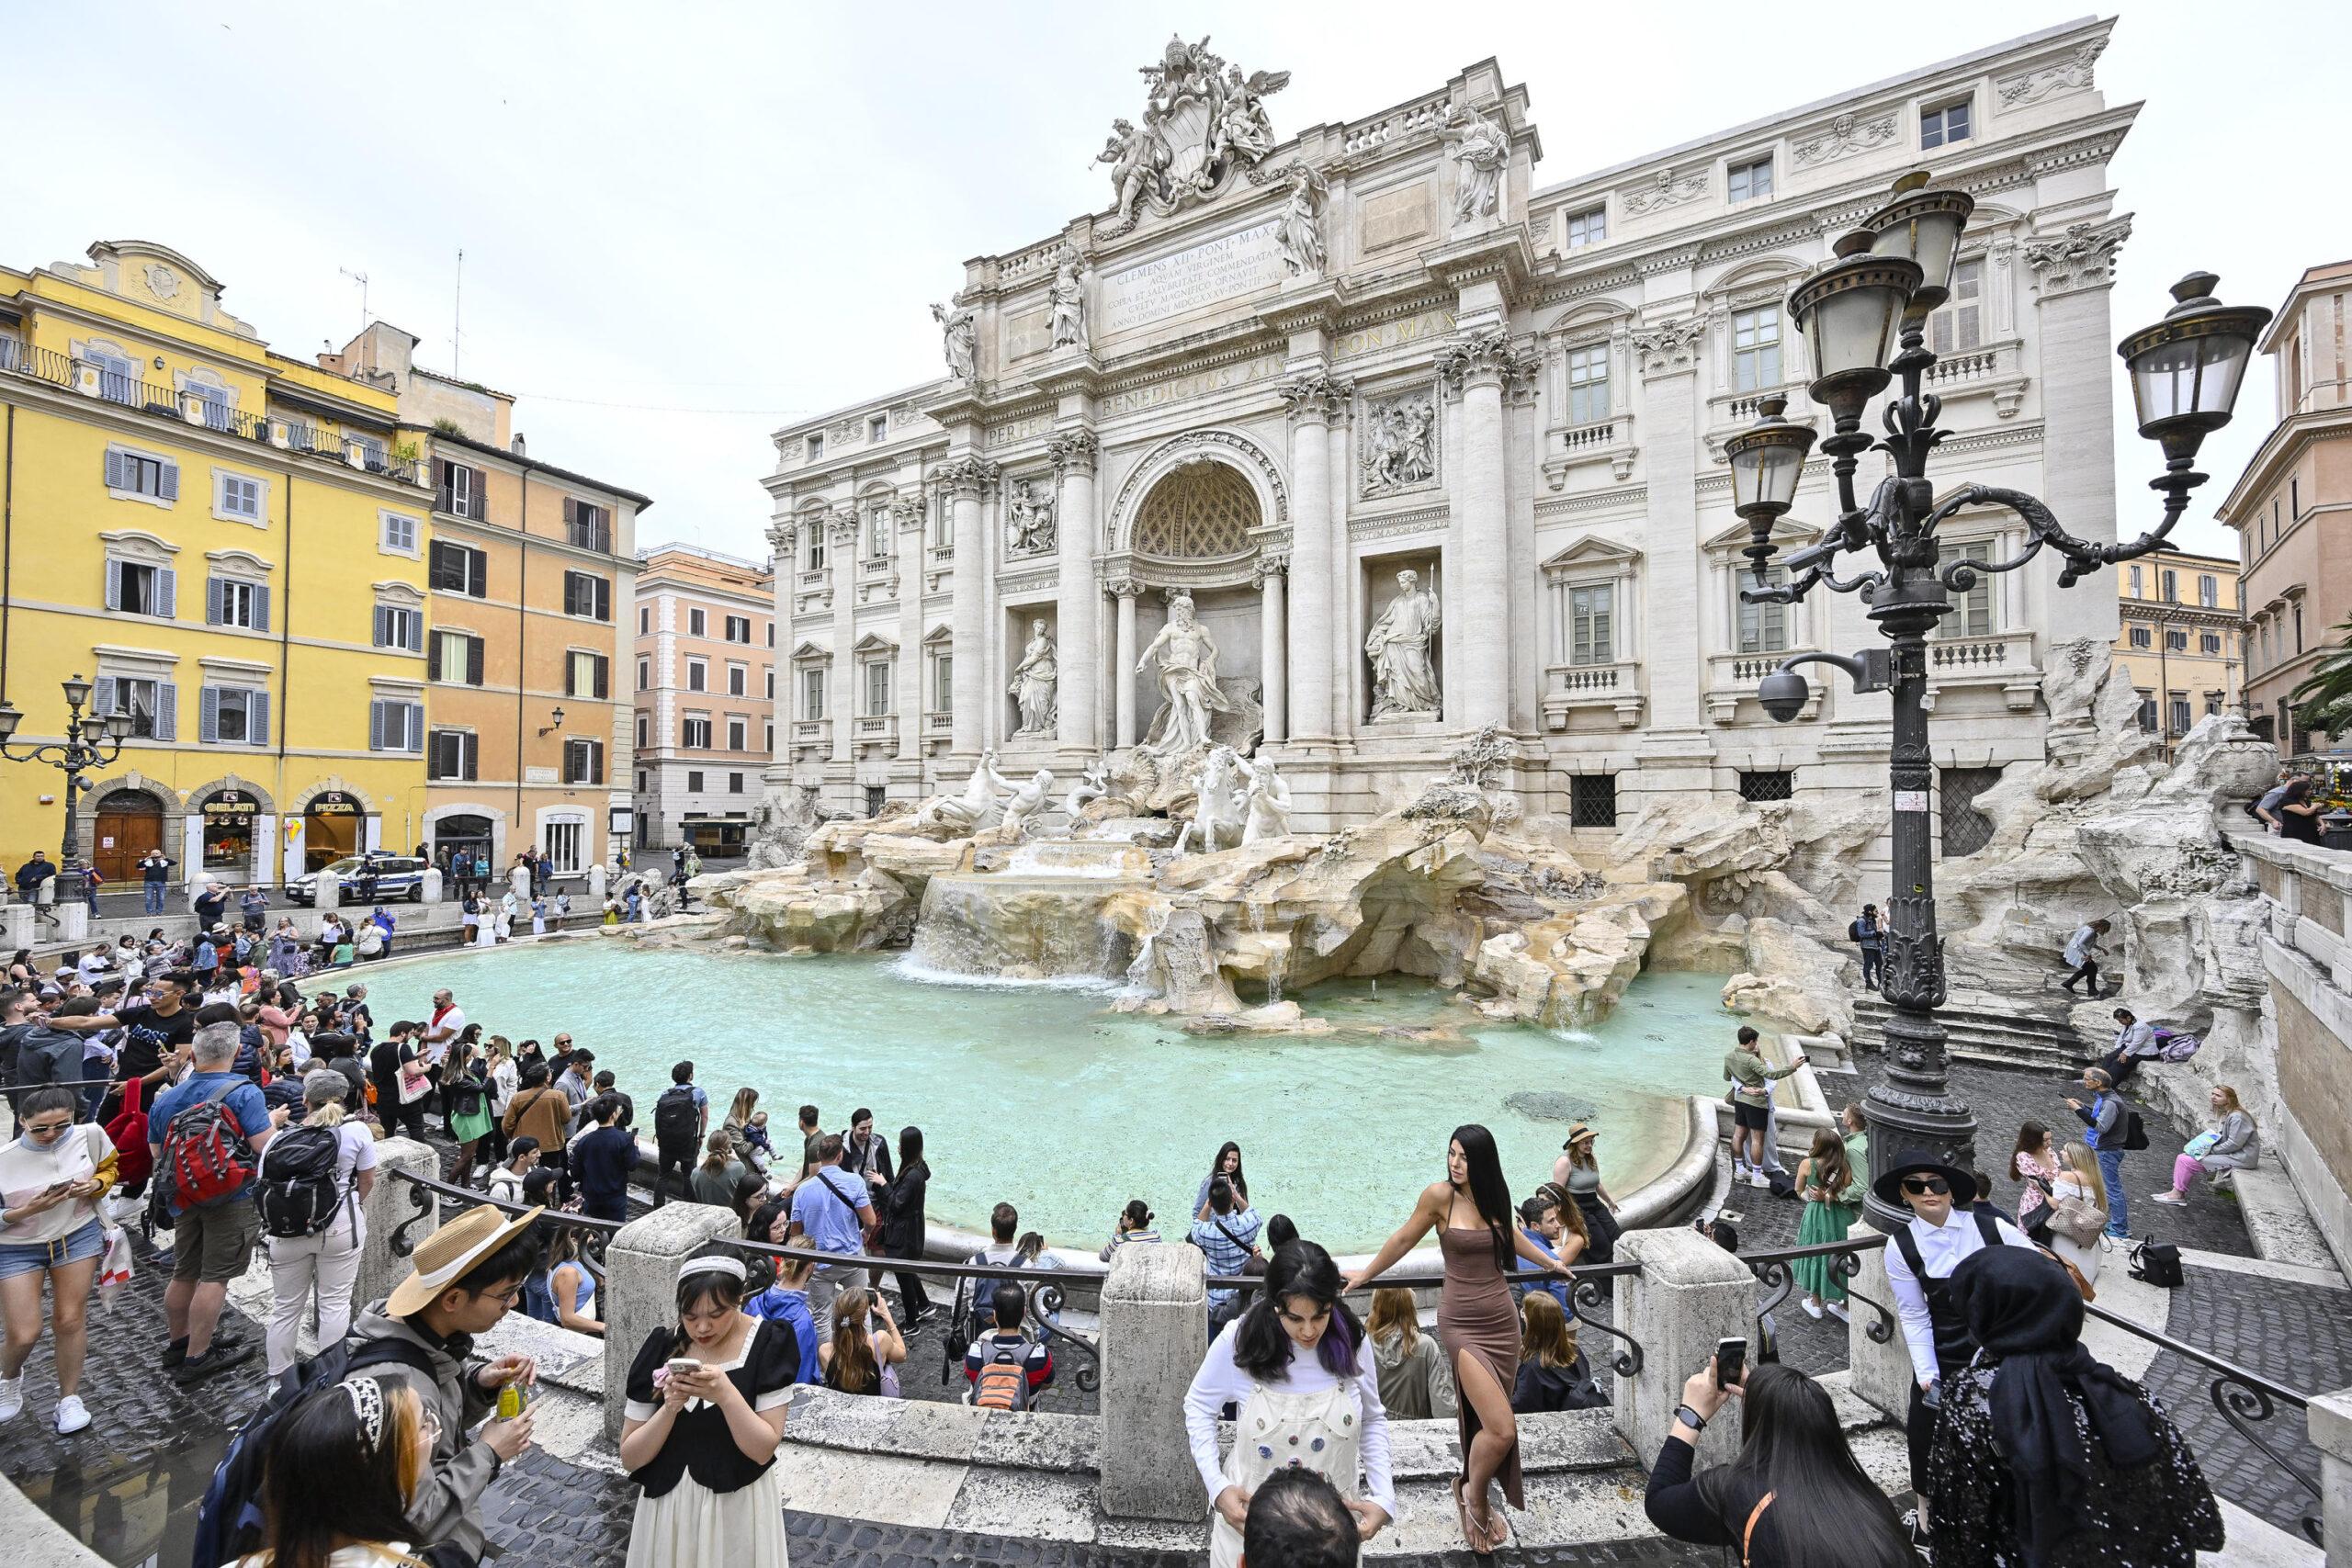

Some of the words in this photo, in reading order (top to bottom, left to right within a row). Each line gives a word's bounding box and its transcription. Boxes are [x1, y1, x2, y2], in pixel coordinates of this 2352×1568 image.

[132, 105, 169, 123] BOSS
[1117, 260, 1166, 285] CLEMENS
[1187, 252, 1233, 273] VIRGINEM
[1136, 290, 1145, 300] ET
[1160, 281, 1211, 303] MAGNIFICO
[1216, 265, 1259, 286] ORNAVIT
[1111, 316, 1136, 330] ANNO
[1138, 306, 1170, 321] DOMINI
[1396, 308, 1457, 342] MAX
[1102, 368, 1230, 414] BENEDICTVS
[1246, 354, 1284, 380] XIV
[205, 802, 255, 812] GELATI
[315, 803, 355, 812] PIZZA
